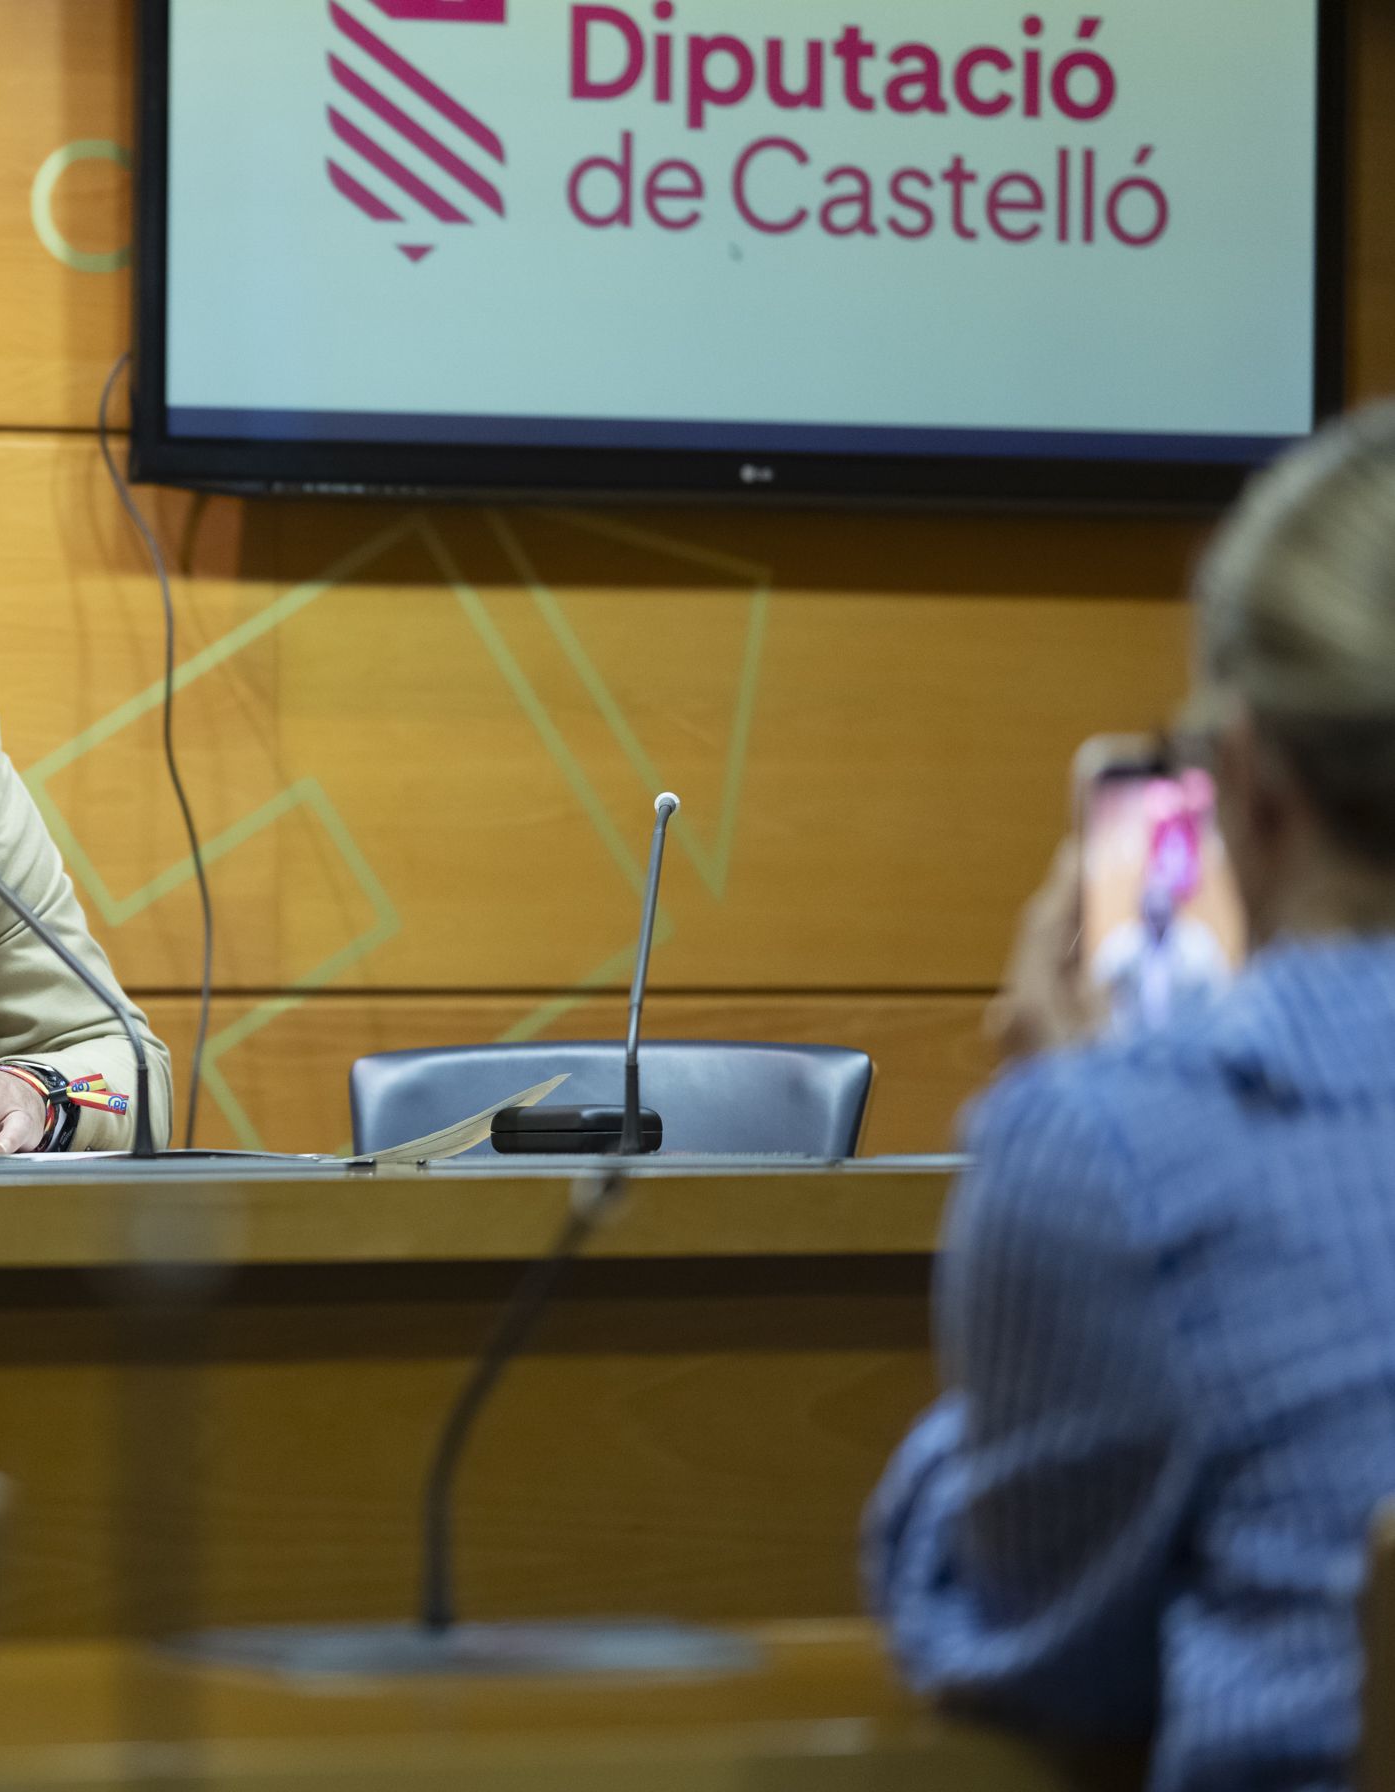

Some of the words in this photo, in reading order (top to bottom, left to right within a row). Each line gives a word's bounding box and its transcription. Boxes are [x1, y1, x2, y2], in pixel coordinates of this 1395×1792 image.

[570, 0, 1117, 130] Diputació
[567, 131, 705, 231] de
[732, 136, 1170, 248] Castelló
